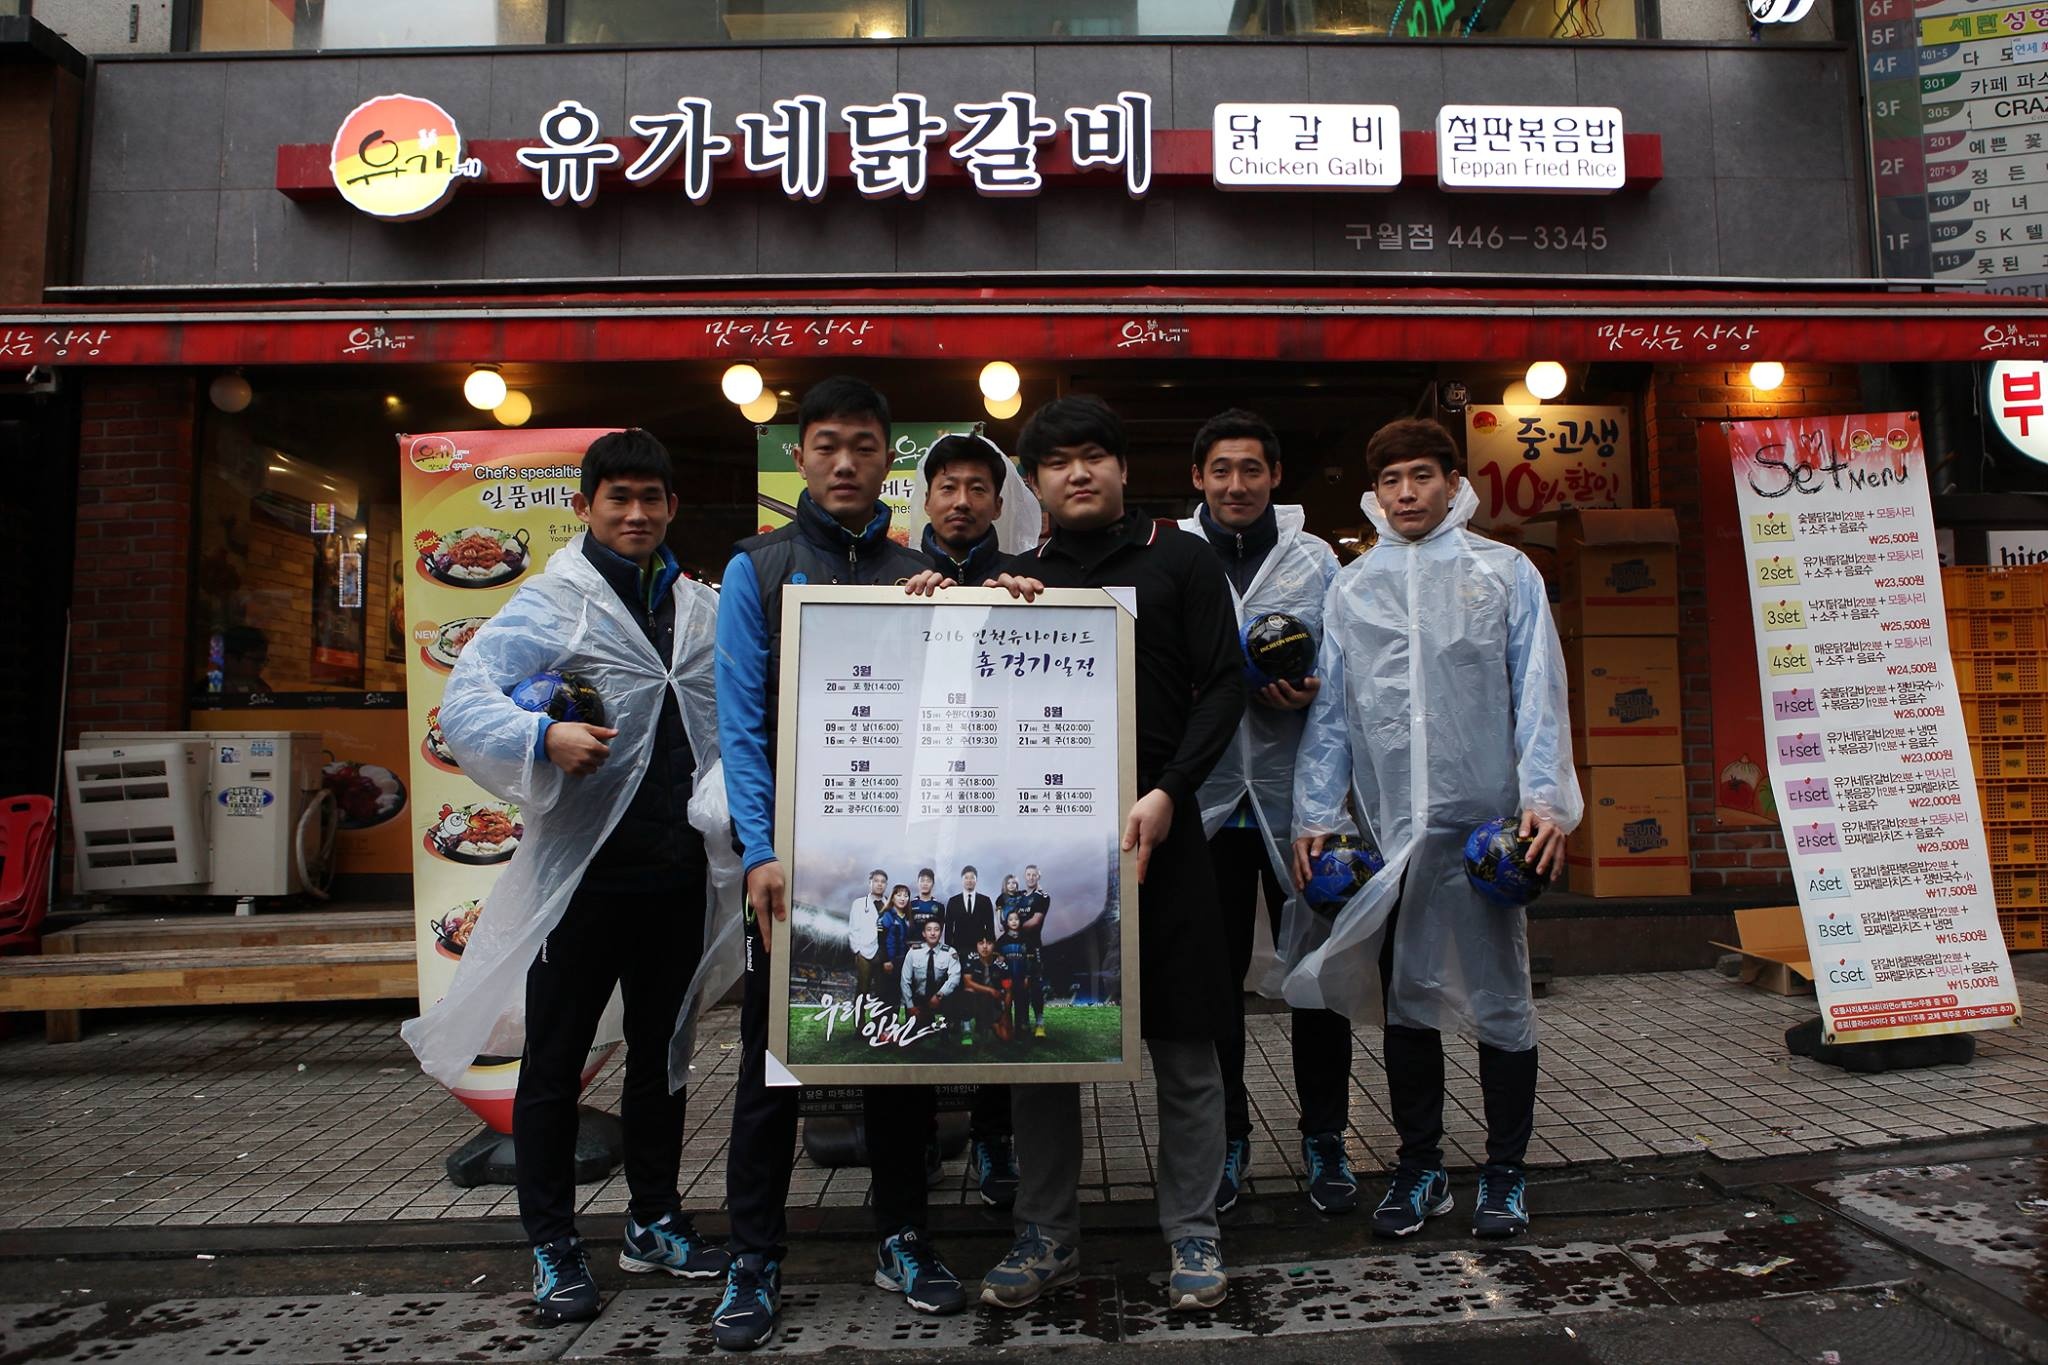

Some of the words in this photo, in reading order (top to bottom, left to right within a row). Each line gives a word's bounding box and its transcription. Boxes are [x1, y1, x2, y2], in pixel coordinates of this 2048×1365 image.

[1870, 0, 1893, 16] 6F
[1872, 28, 1895, 45] 5F
[1873, 57, 1896, 73] 4F
[1924, 78, 1946, 89] 301
[1971, 76, 2007, 94] 카페
[1876, 100, 1900, 117] 3F
[1928, 107, 1950, 118] 305
[1447, 114, 1616, 154] 철판볶음밥
[517, 91, 1151, 201] 유가네닭갈비
[1930, 137, 1951, 148] 201
[1229, 156, 1320, 176] Chicken
[1328, 156, 1384, 176] Galbi
[1450, 156, 1517, 179] Teppan
[1524, 158, 1570, 178] Fried
[1577, 158, 1617, 178] Rice
[1880, 158, 1904, 176] 2F
[1930, 166, 1956, 177] 207-9
[1936, 196, 1956, 206] 101
[1344, 223, 1434, 250] 구월점
[1447, 225, 1608, 250] 446-3345
[1936, 226, 1958, 237] 109
[1886, 234, 1910, 250] 1F
[1939, 255, 1960, 266] 113
[704, 320, 794, 348] 맛있는
[804, 319, 874, 347] 상상
[1598, 323, 1684, 351] 맛있는
[1693, 324, 1760, 350] 상상
[1517, 417, 1619, 461] 중·고생
[474, 466, 518, 480] Chef's
[1748, 438, 1849, 499] Set
[1850, 464, 1909, 493] Menu
[1478, 460, 1567, 518] 10%
[1564, 462, 1620, 502] 할인
[1756, 522, 1787, 536] 1set
[1809, 524, 1828, 536] 소주
[1760, 565, 1794, 580] 2set
[1814, 566, 1834, 578] 소주
[1767, 609, 1800, 625] 3set
[1820, 610, 1840, 622] 소주
[414, 630, 440, 640] NEW
[922, 630, 964, 643] 2016
[973, 628, 1095, 644] 인천유나이티드
[1773, 653, 1807, 668] 4set
[1825, 654, 1846, 666] 소주
[852, 665, 872, 678] 3월
[826, 682, 836, 691] 20
[852, 706, 871, 718] 4월
[1044, 706, 1062, 718] 8월
[1776, 698, 1814, 713] 가set
[826, 723, 836, 732] 09
[1018, 724, 1028, 732] 17
[826, 736, 836, 744] 16
[1019, 736, 1028, 745] 21
[1782, 742, 1822, 758] 나set
[850, 760, 870, 772] 5월
[948, 760, 966, 772] 7월
[824, 778, 834, 786] 01
[1044, 774, 1064, 786] 9월
[824, 792, 834, 800] 05
[1019, 792, 1028, 800] 10
[1790, 787, 1830, 802] 다set
[824, 805, 834, 814] 22
[1019, 805, 1029, 814] 24
[1622, 824, 1662, 836] SUN
[1798, 832, 1838, 848] 라set
[1809, 877, 1842, 892] Aset
[1818, 922, 1854, 938] Bset
[1830, 967, 1866, 984] Cset
